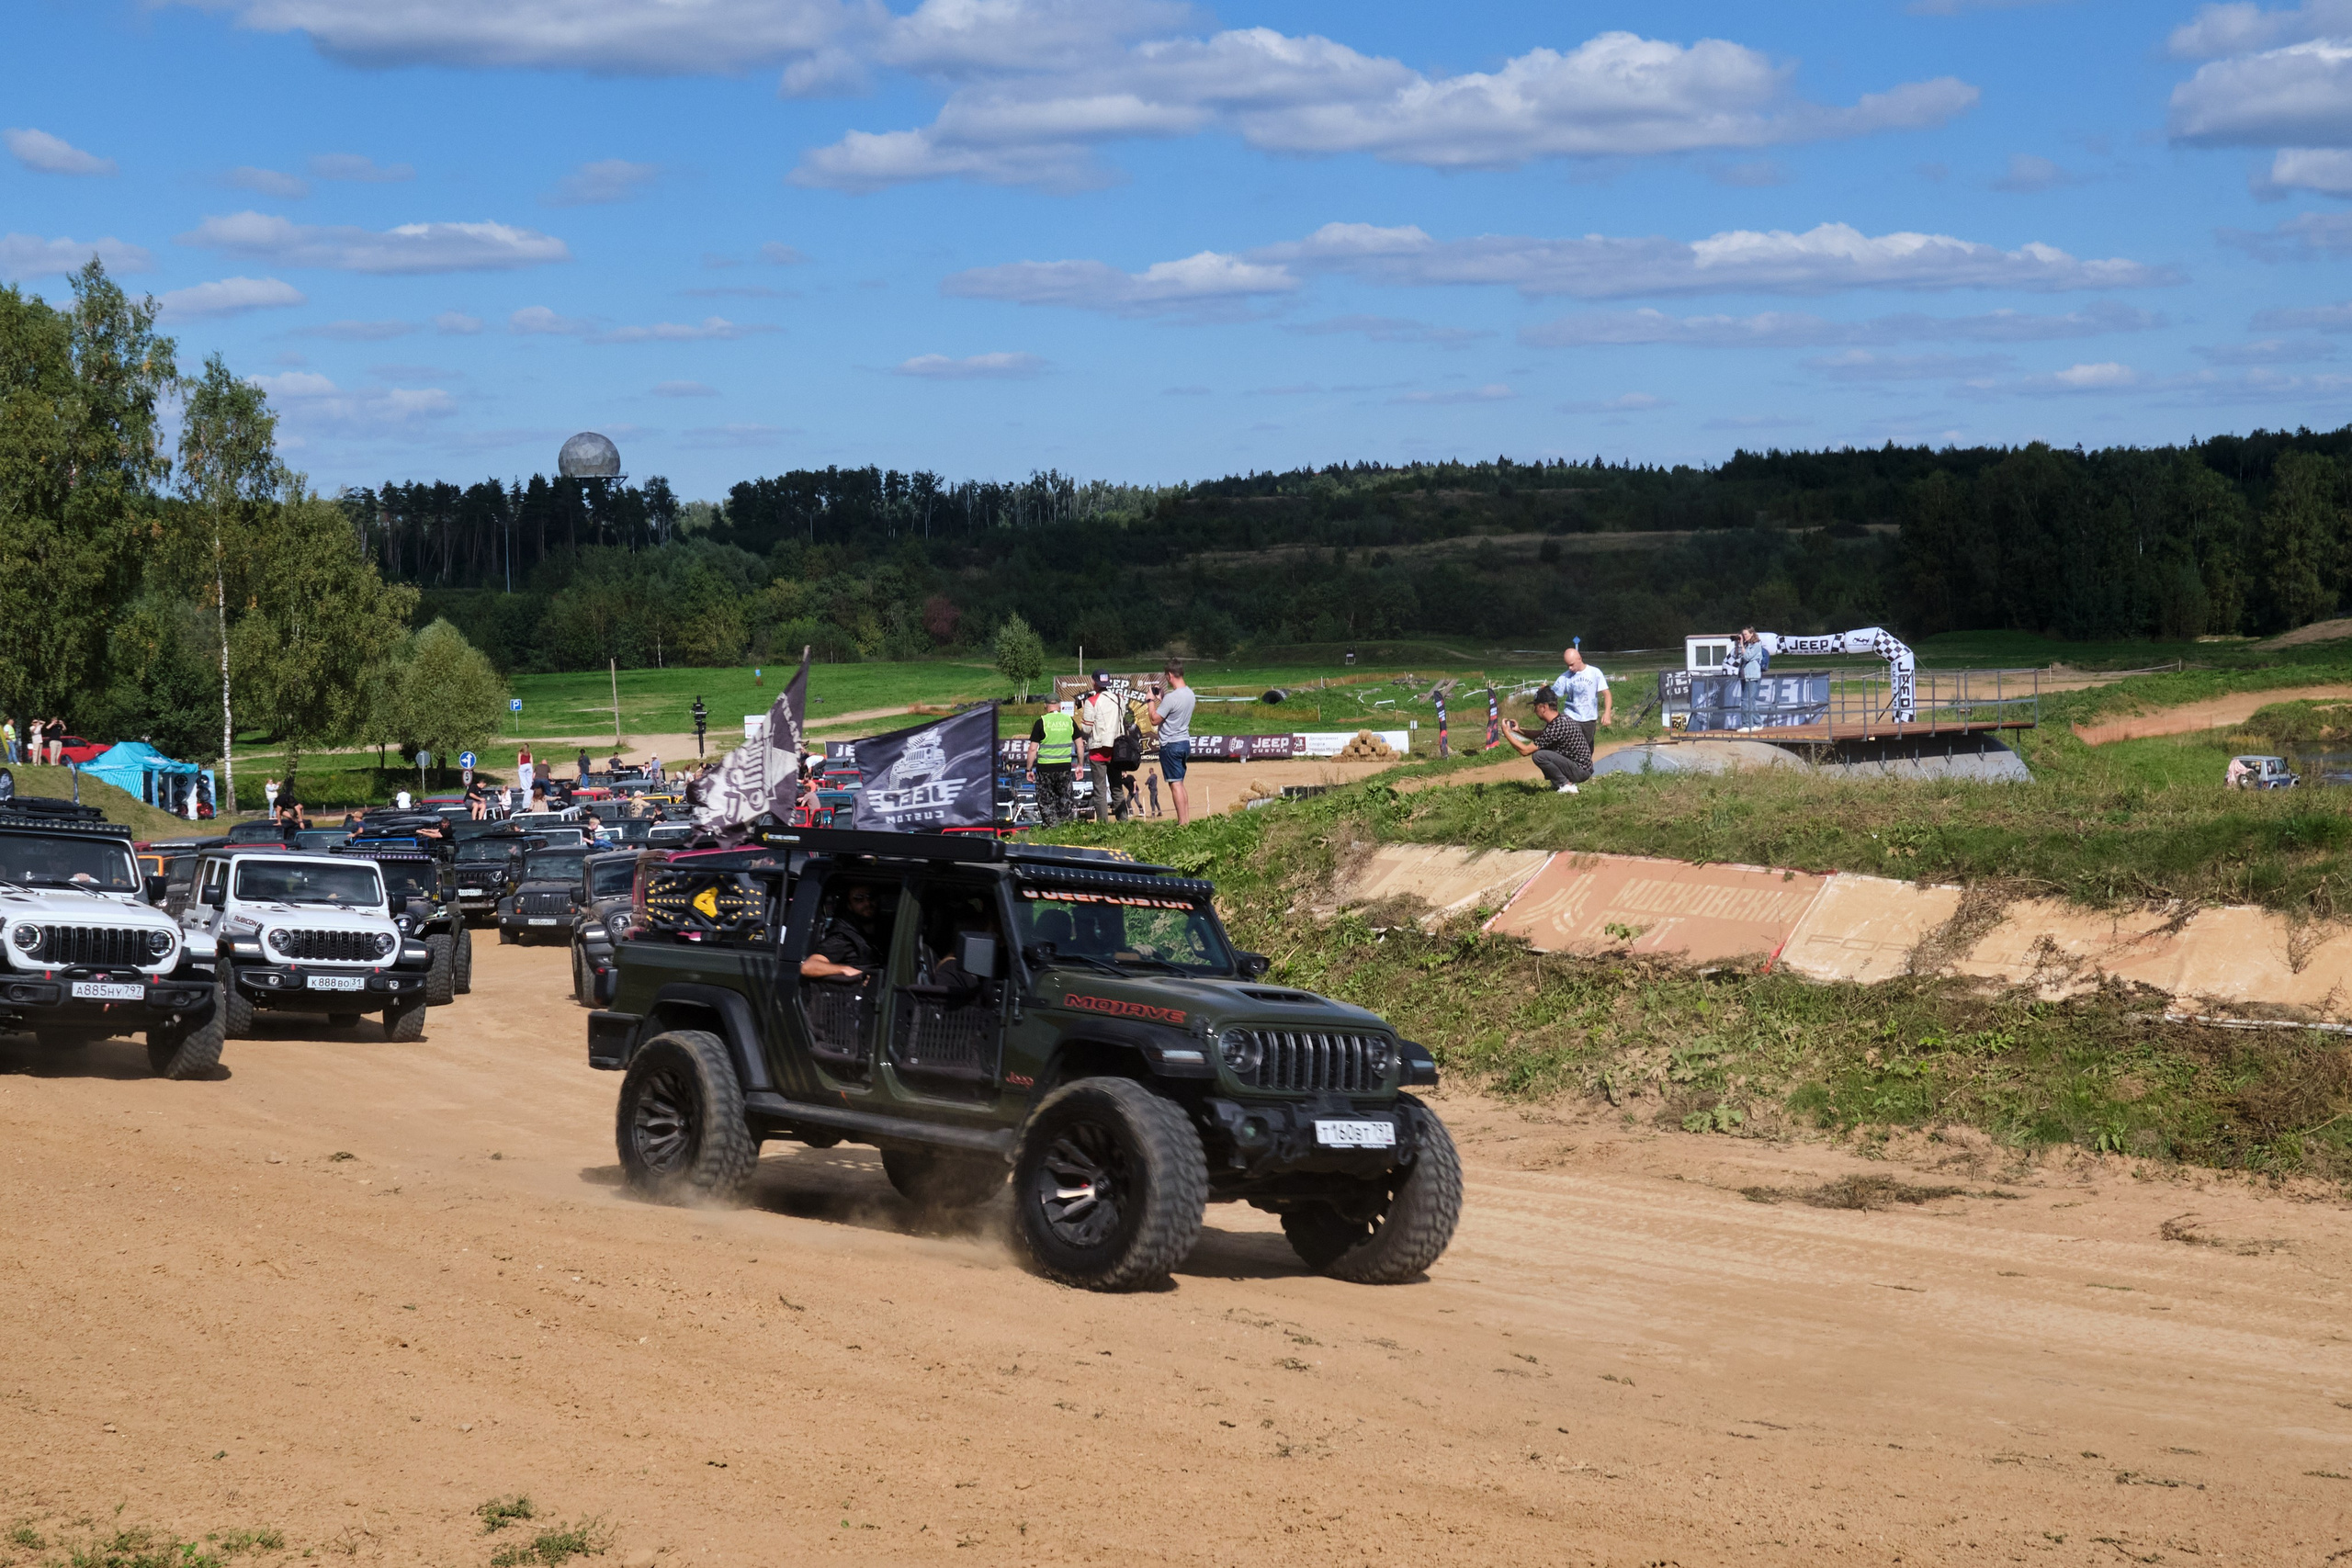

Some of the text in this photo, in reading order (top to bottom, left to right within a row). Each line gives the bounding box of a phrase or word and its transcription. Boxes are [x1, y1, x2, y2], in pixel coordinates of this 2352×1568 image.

[1789, 639, 1828, 650] JEEP
[513, 700, 520, 710] P
[1189, 736, 1223, 747] EEP
[1251, 738, 1289, 748] JEEP
[1609, 878, 1815, 923] МОСКОВСКИЙ
[233, 915, 258, 928] RUBICON
[351, 977, 362, 986] 31
[124, 985, 141, 995] 797
[1064, 993, 1188, 1023] MOJAVE
[1005, 1071, 1035, 1089] Jeep
